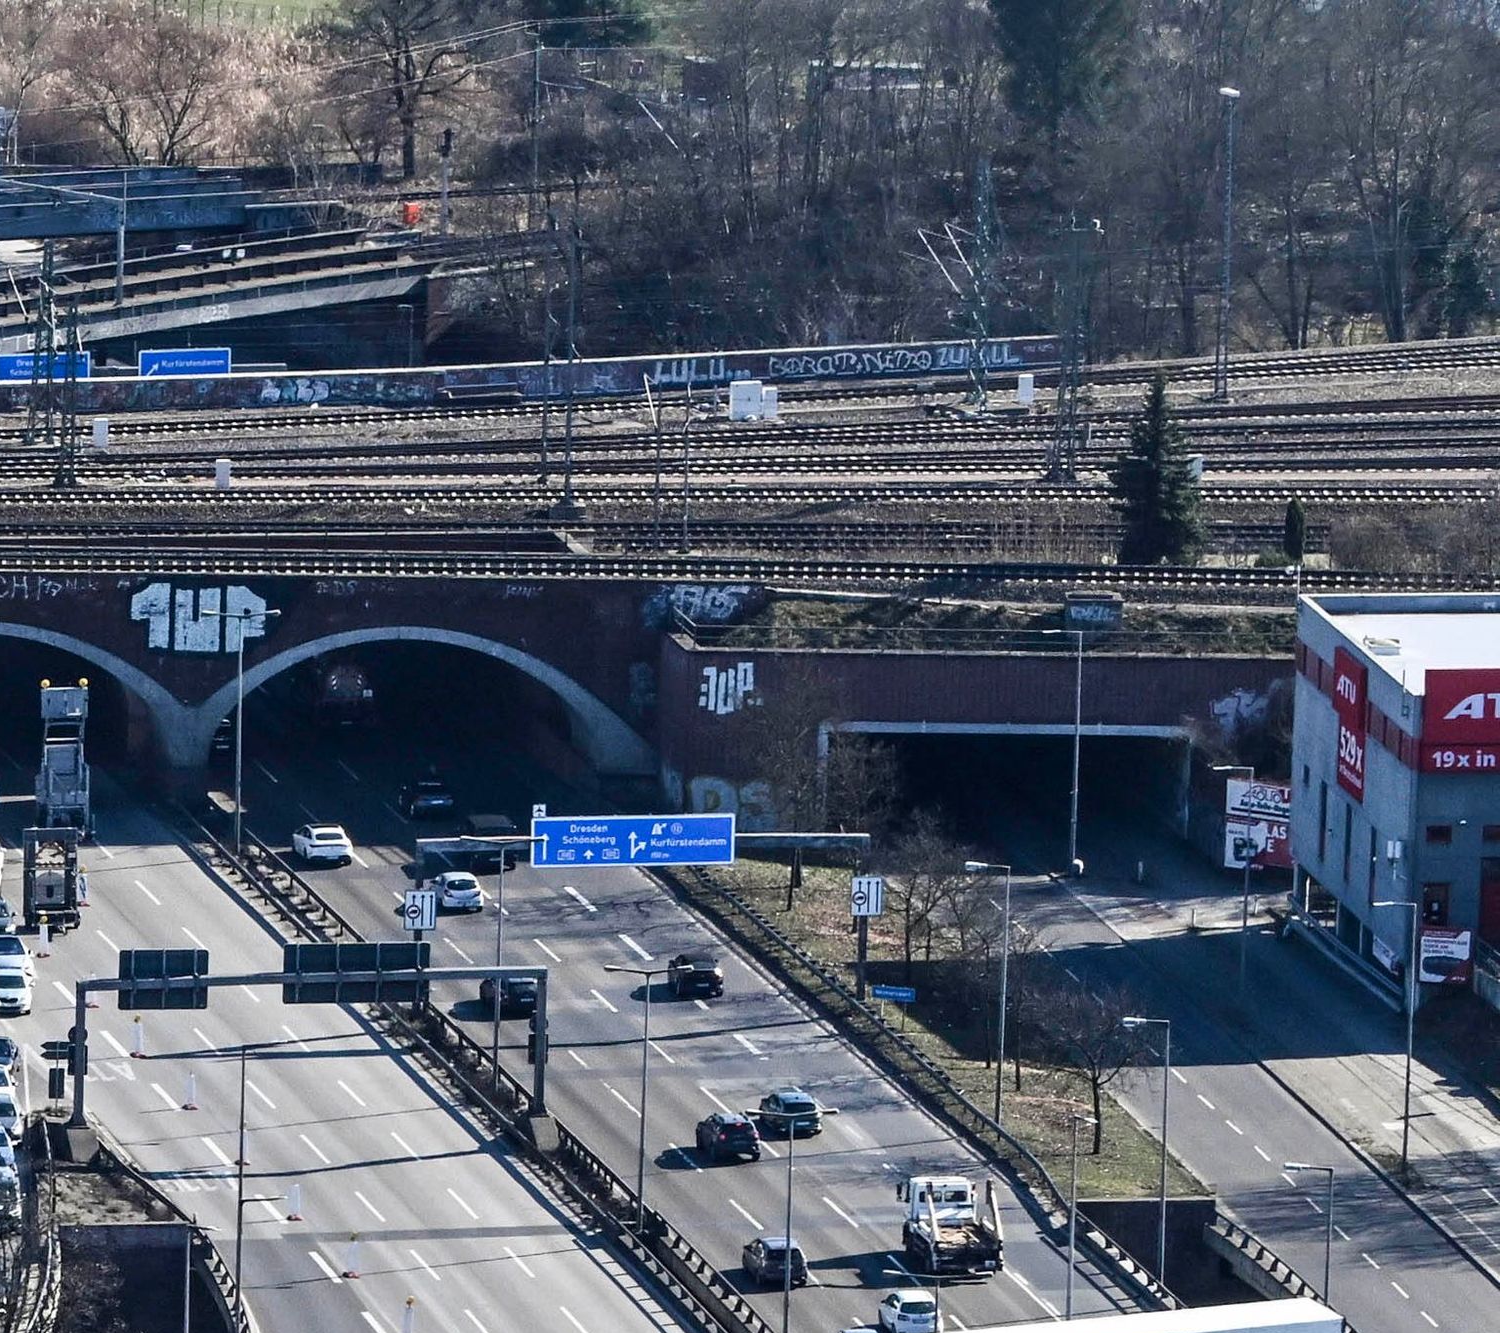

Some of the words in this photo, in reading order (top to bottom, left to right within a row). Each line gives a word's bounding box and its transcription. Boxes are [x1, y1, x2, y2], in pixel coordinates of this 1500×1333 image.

[1335, 674, 1357, 705] ATU
[1476, 750, 1497, 767] in
[570, 824, 609, 833] Dresden
[562, 834, 616, 845] Schöneberg
[650, 837, 728, 848] Kurfürstendamm
